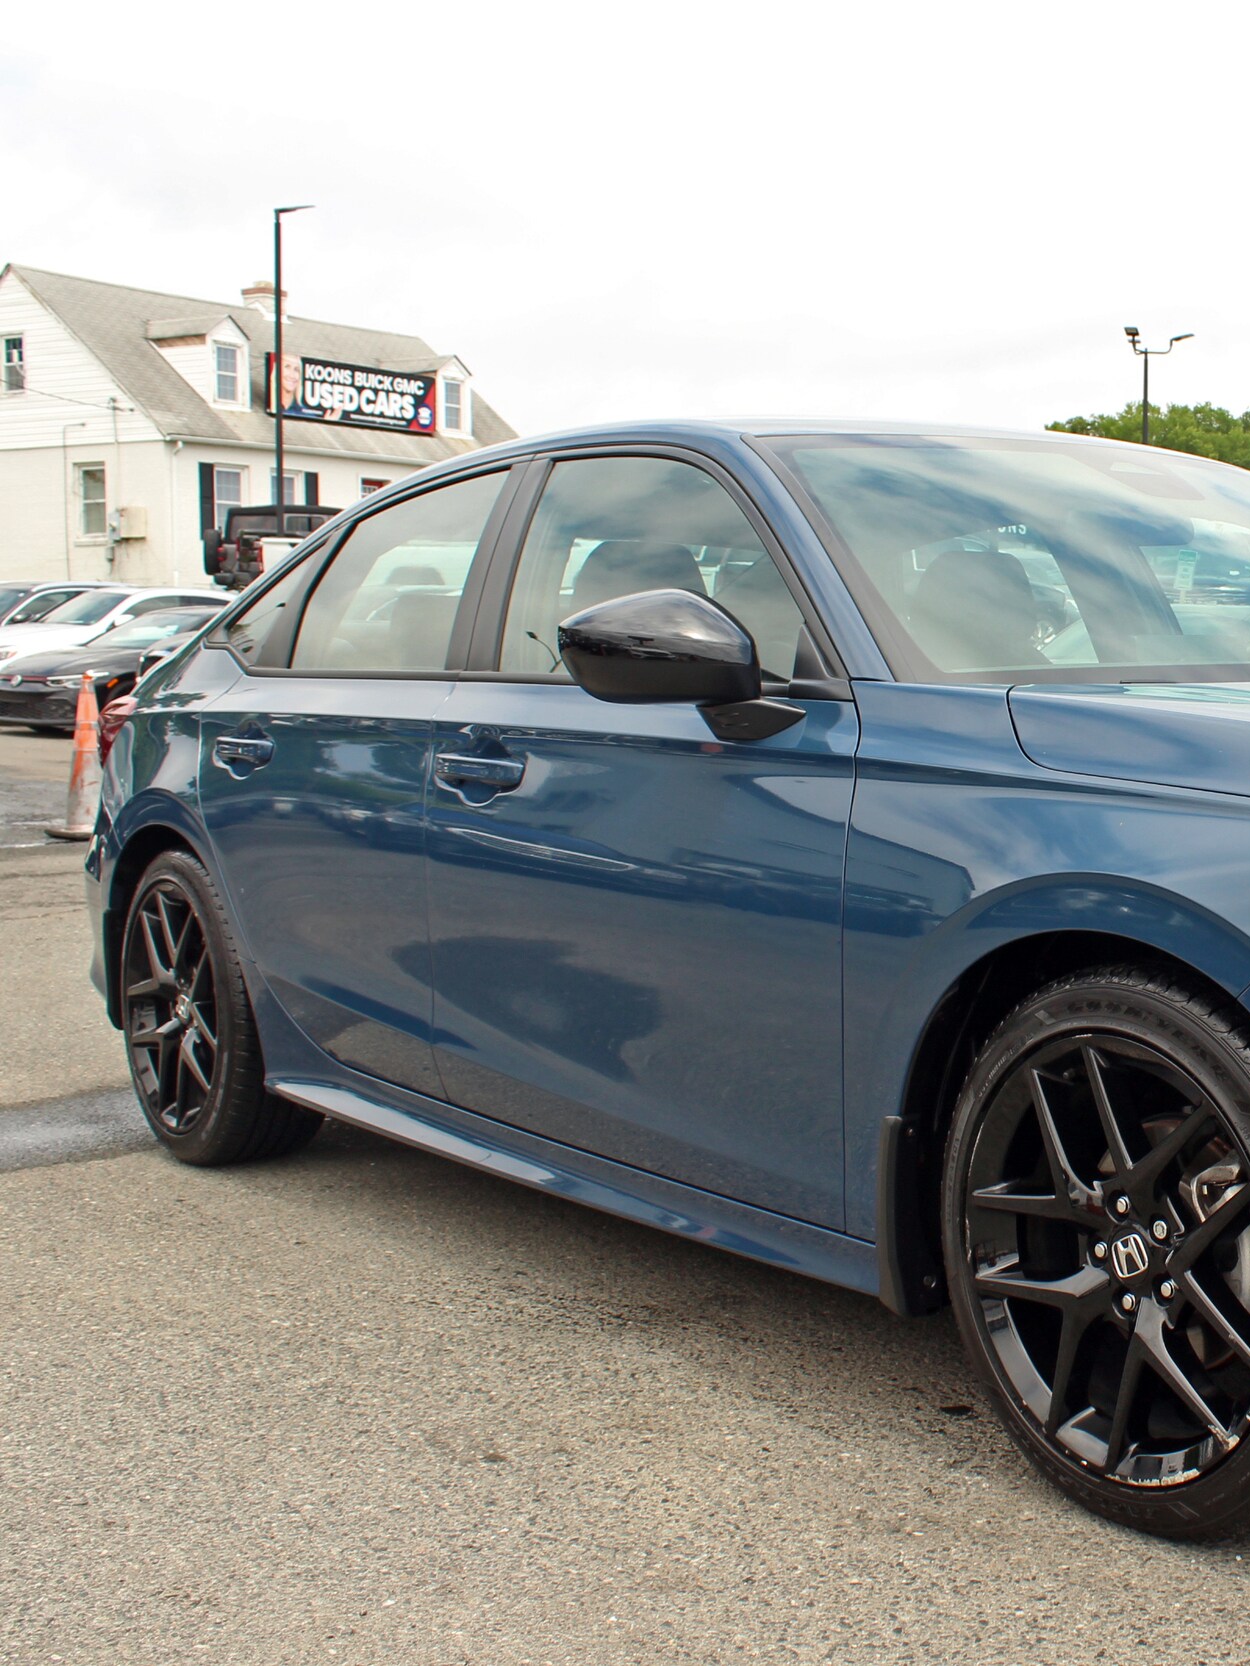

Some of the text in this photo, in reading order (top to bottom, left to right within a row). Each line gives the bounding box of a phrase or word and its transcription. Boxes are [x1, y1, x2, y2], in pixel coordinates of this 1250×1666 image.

[305, 363, 425, 395] KOONS BUICK GMC
[304, 380, 359, 411] USED
[360, 388, 415, 419] CARS
